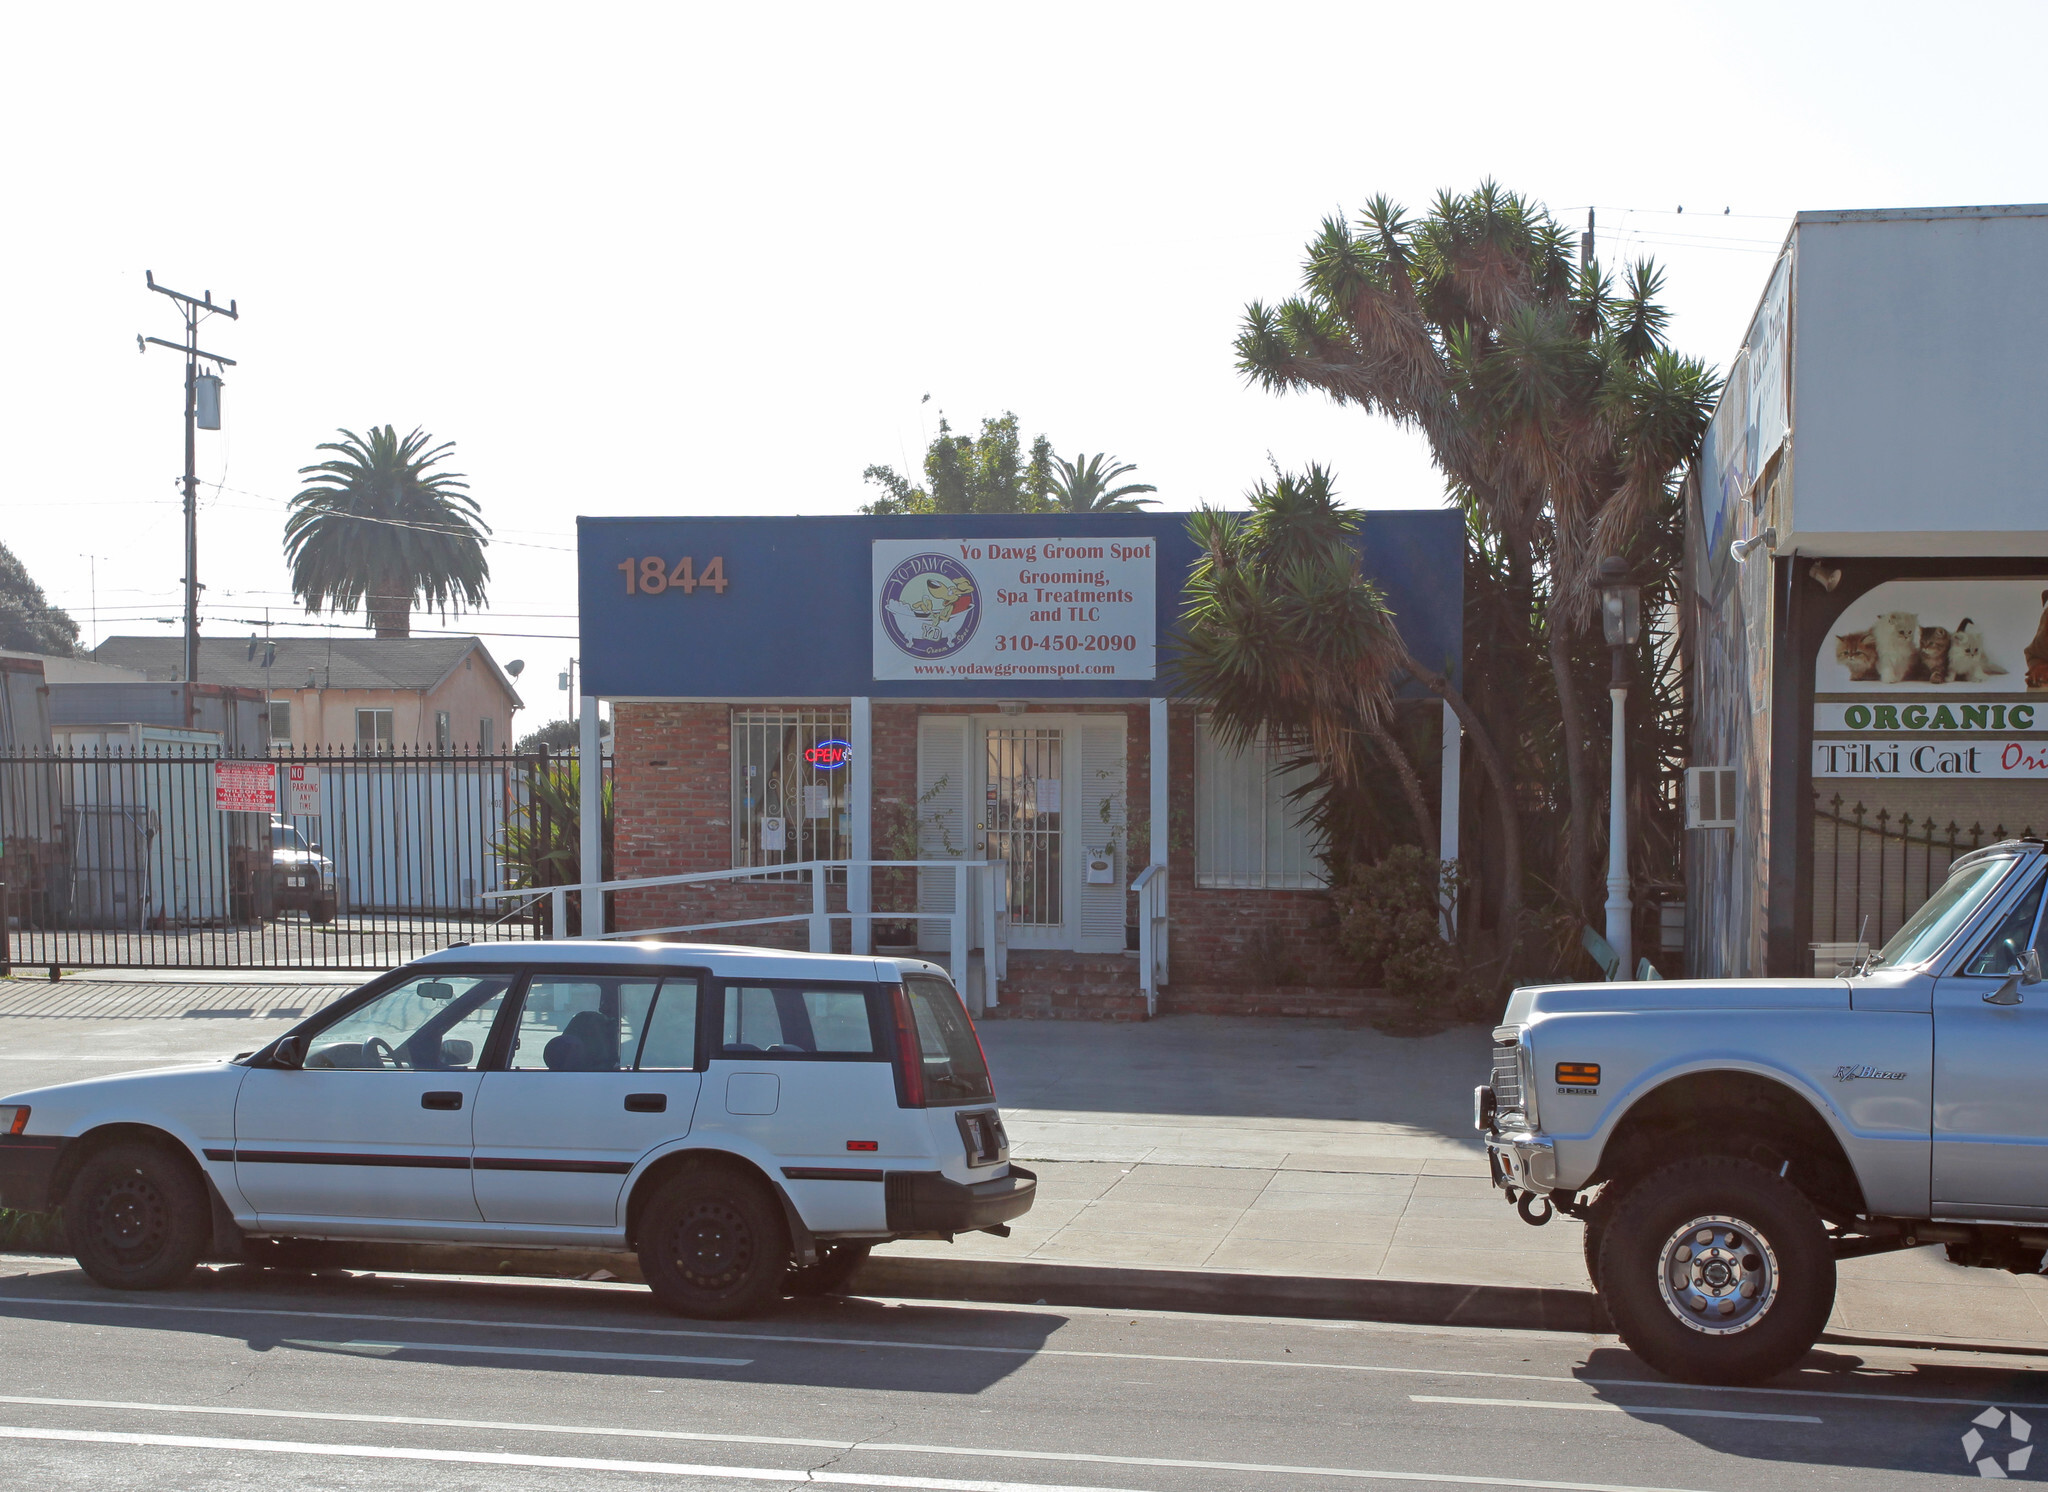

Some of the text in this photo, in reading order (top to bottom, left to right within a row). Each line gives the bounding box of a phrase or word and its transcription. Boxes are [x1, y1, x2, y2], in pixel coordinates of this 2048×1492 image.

[960, 542, 1152, 563] Yo Dawg Groom Spot
[617, 555, 729, 595] 1844
[1019, 569, 1110, 588] Grooming,
[996, 588, 1133, 607] Spa Treatments
[1029, 607, 1101, 622] and TLC
[994, 634, 1137, 652] 310-450-2090
[913, 663, 1116, 677] www.yodawggroomspot.com
[1844, 704, 2035, 730] ORGANIC
[804, 748, 843, 762] OPEN
[1818, 743, 2048, 773] Tiki Cat Ori
[291, 767, 303, 779] NO
[292, 783, 319, 792] PARKING
[299, 802, 312, 811] TIME
[1860, 1065, 1907, 1081] Blazer
